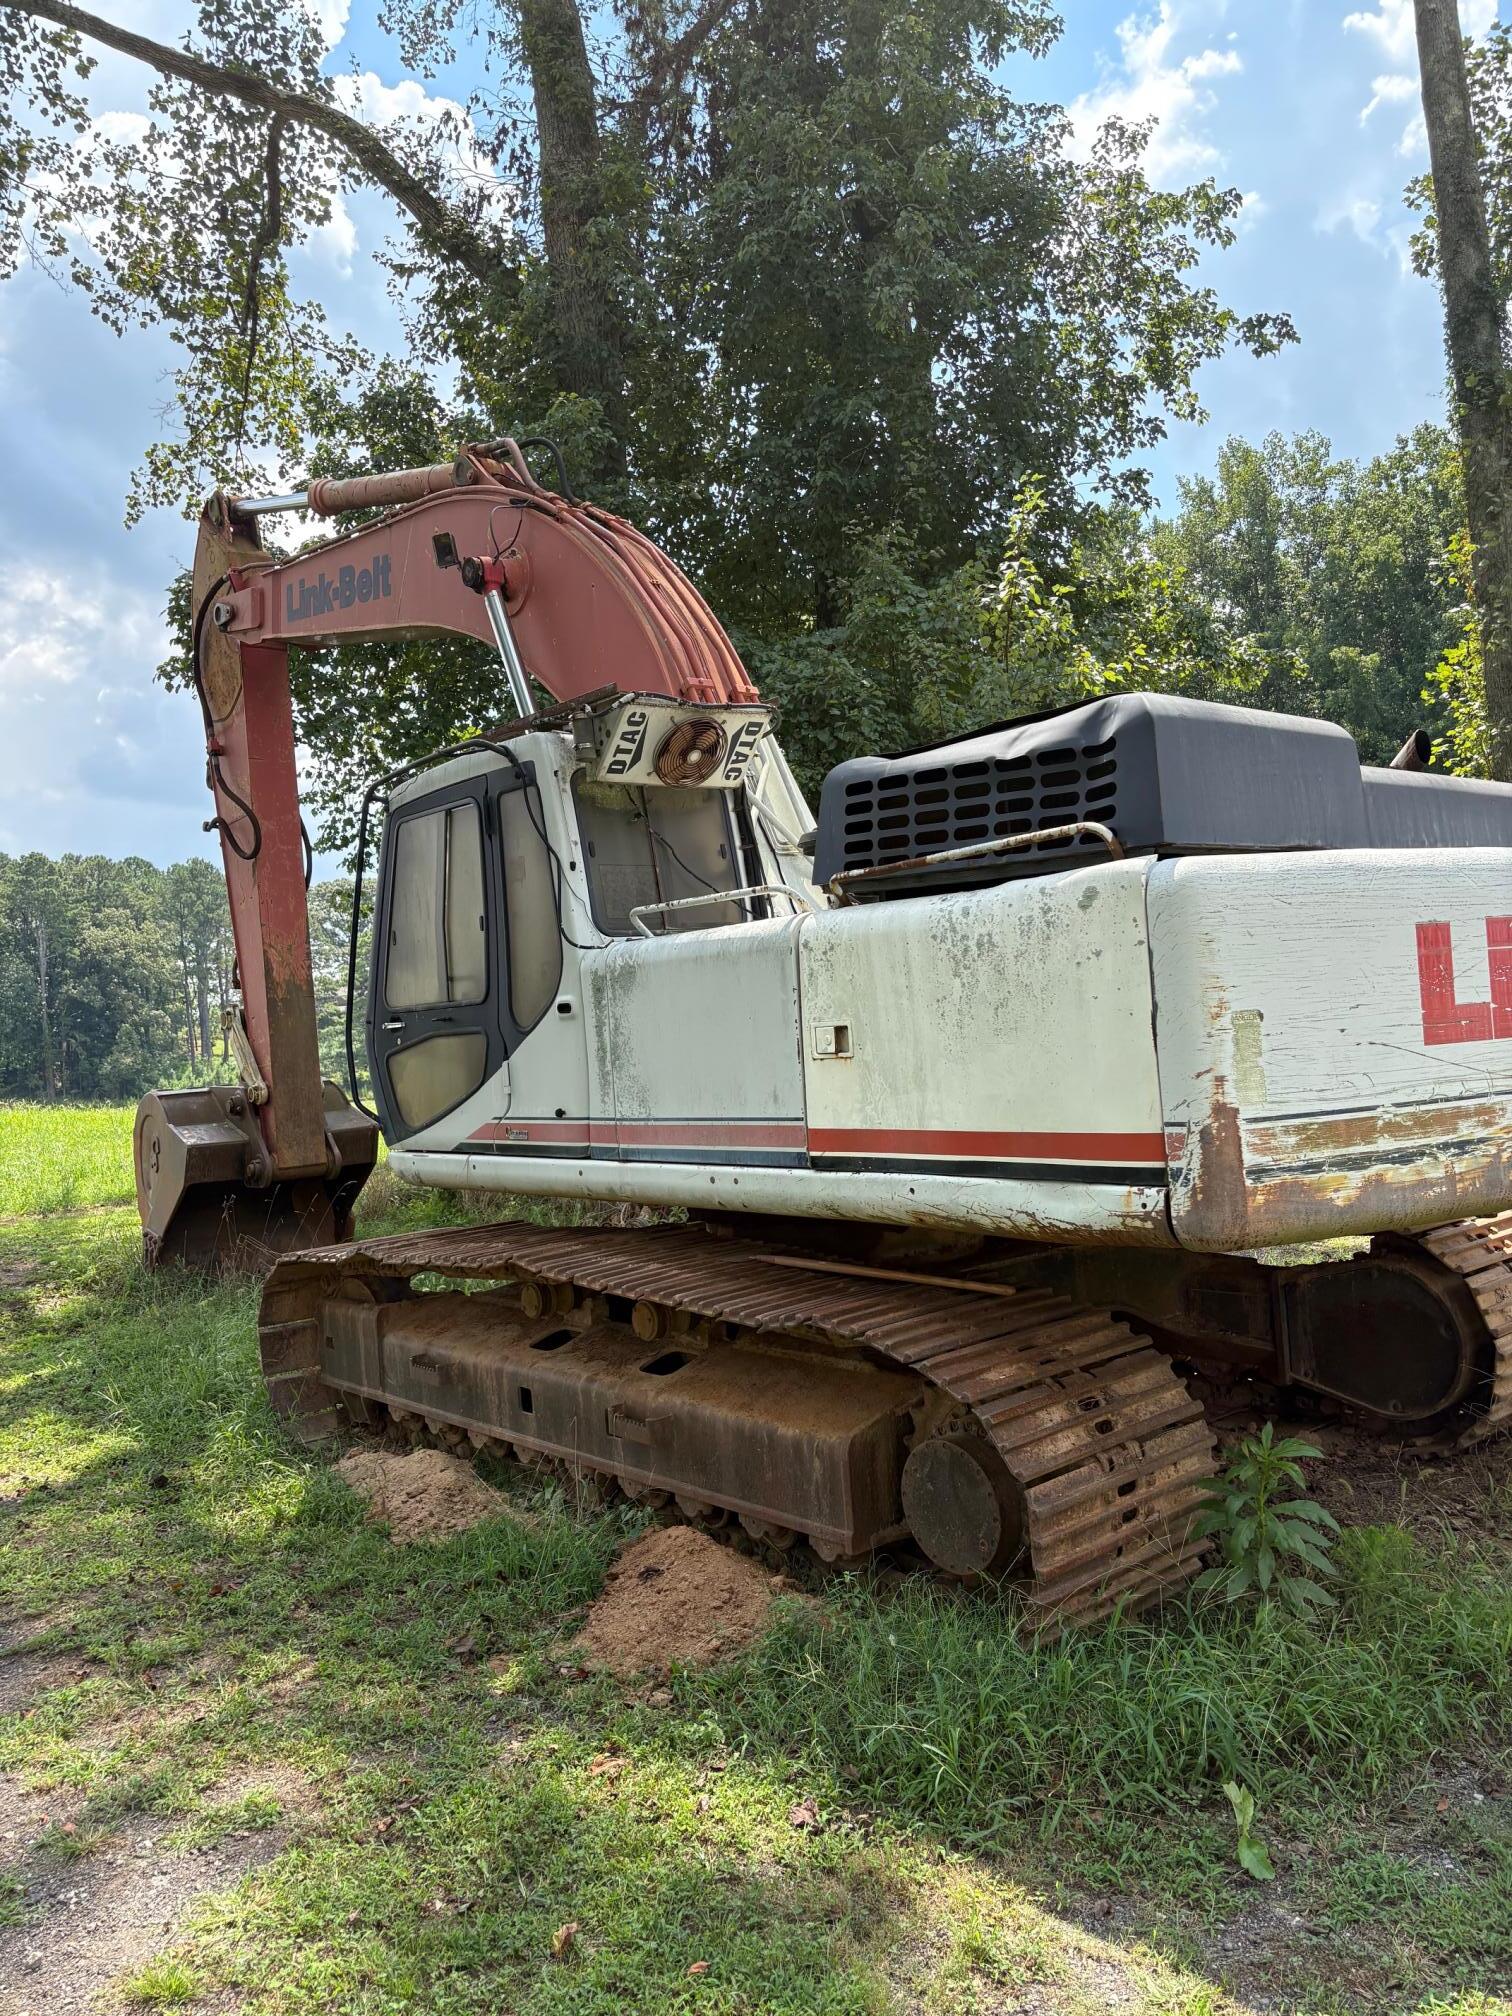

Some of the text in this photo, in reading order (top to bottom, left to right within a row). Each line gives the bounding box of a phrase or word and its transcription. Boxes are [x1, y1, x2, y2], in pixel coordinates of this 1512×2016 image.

[286, 554, 391, 622] Link-Belt
[606, 711, 647, 775] DTAC
[724, 721, 764, 781] DTAC
